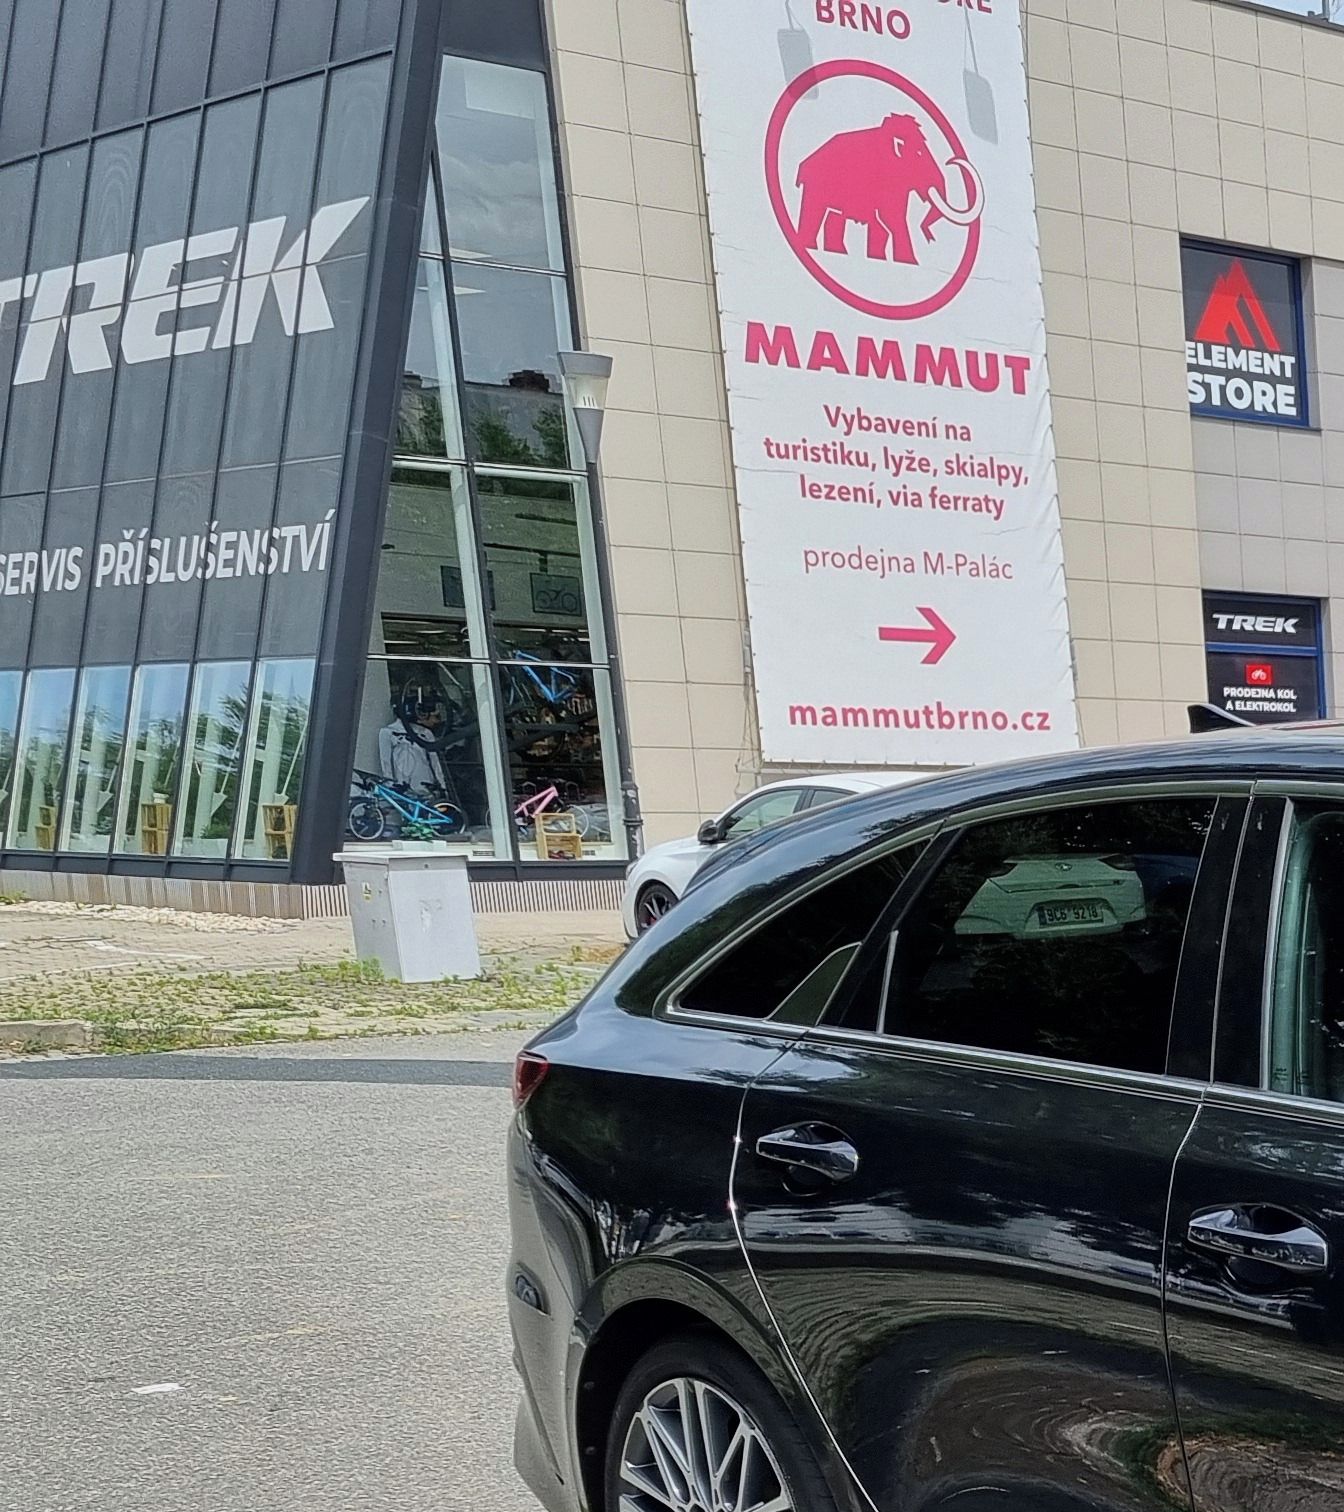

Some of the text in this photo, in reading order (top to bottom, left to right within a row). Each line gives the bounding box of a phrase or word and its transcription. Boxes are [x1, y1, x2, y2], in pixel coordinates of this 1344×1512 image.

[816, 0, 911, 40] BRNO
[0, 196, 371, 386] TREK
[744, 321, 1031, 396] MAMMUT
[1184, 340, 1296, 378] ELEMENT
[1187, 371, 1298, 417] STORE
[823, 403, 972, 443] Vybavení na
[763, 436, 1030, 487] turistiku, lyže, skialpy,
[799, 474, 1005, 521] lezení, via ferraty
[95, 509, 336, 589] PŘÍSLUŠENSTVÍ
[803, 545, 1015, 580] prodejna M-Palác
[1212, 613, 1300, 634] TREK
[1223, 687, 1297, 700] PRODEJNA KOL
[1225, 700, 1297, 713] A ELEKTROKOL
[788, 701, 1052, 732] mammutbrno.cz
